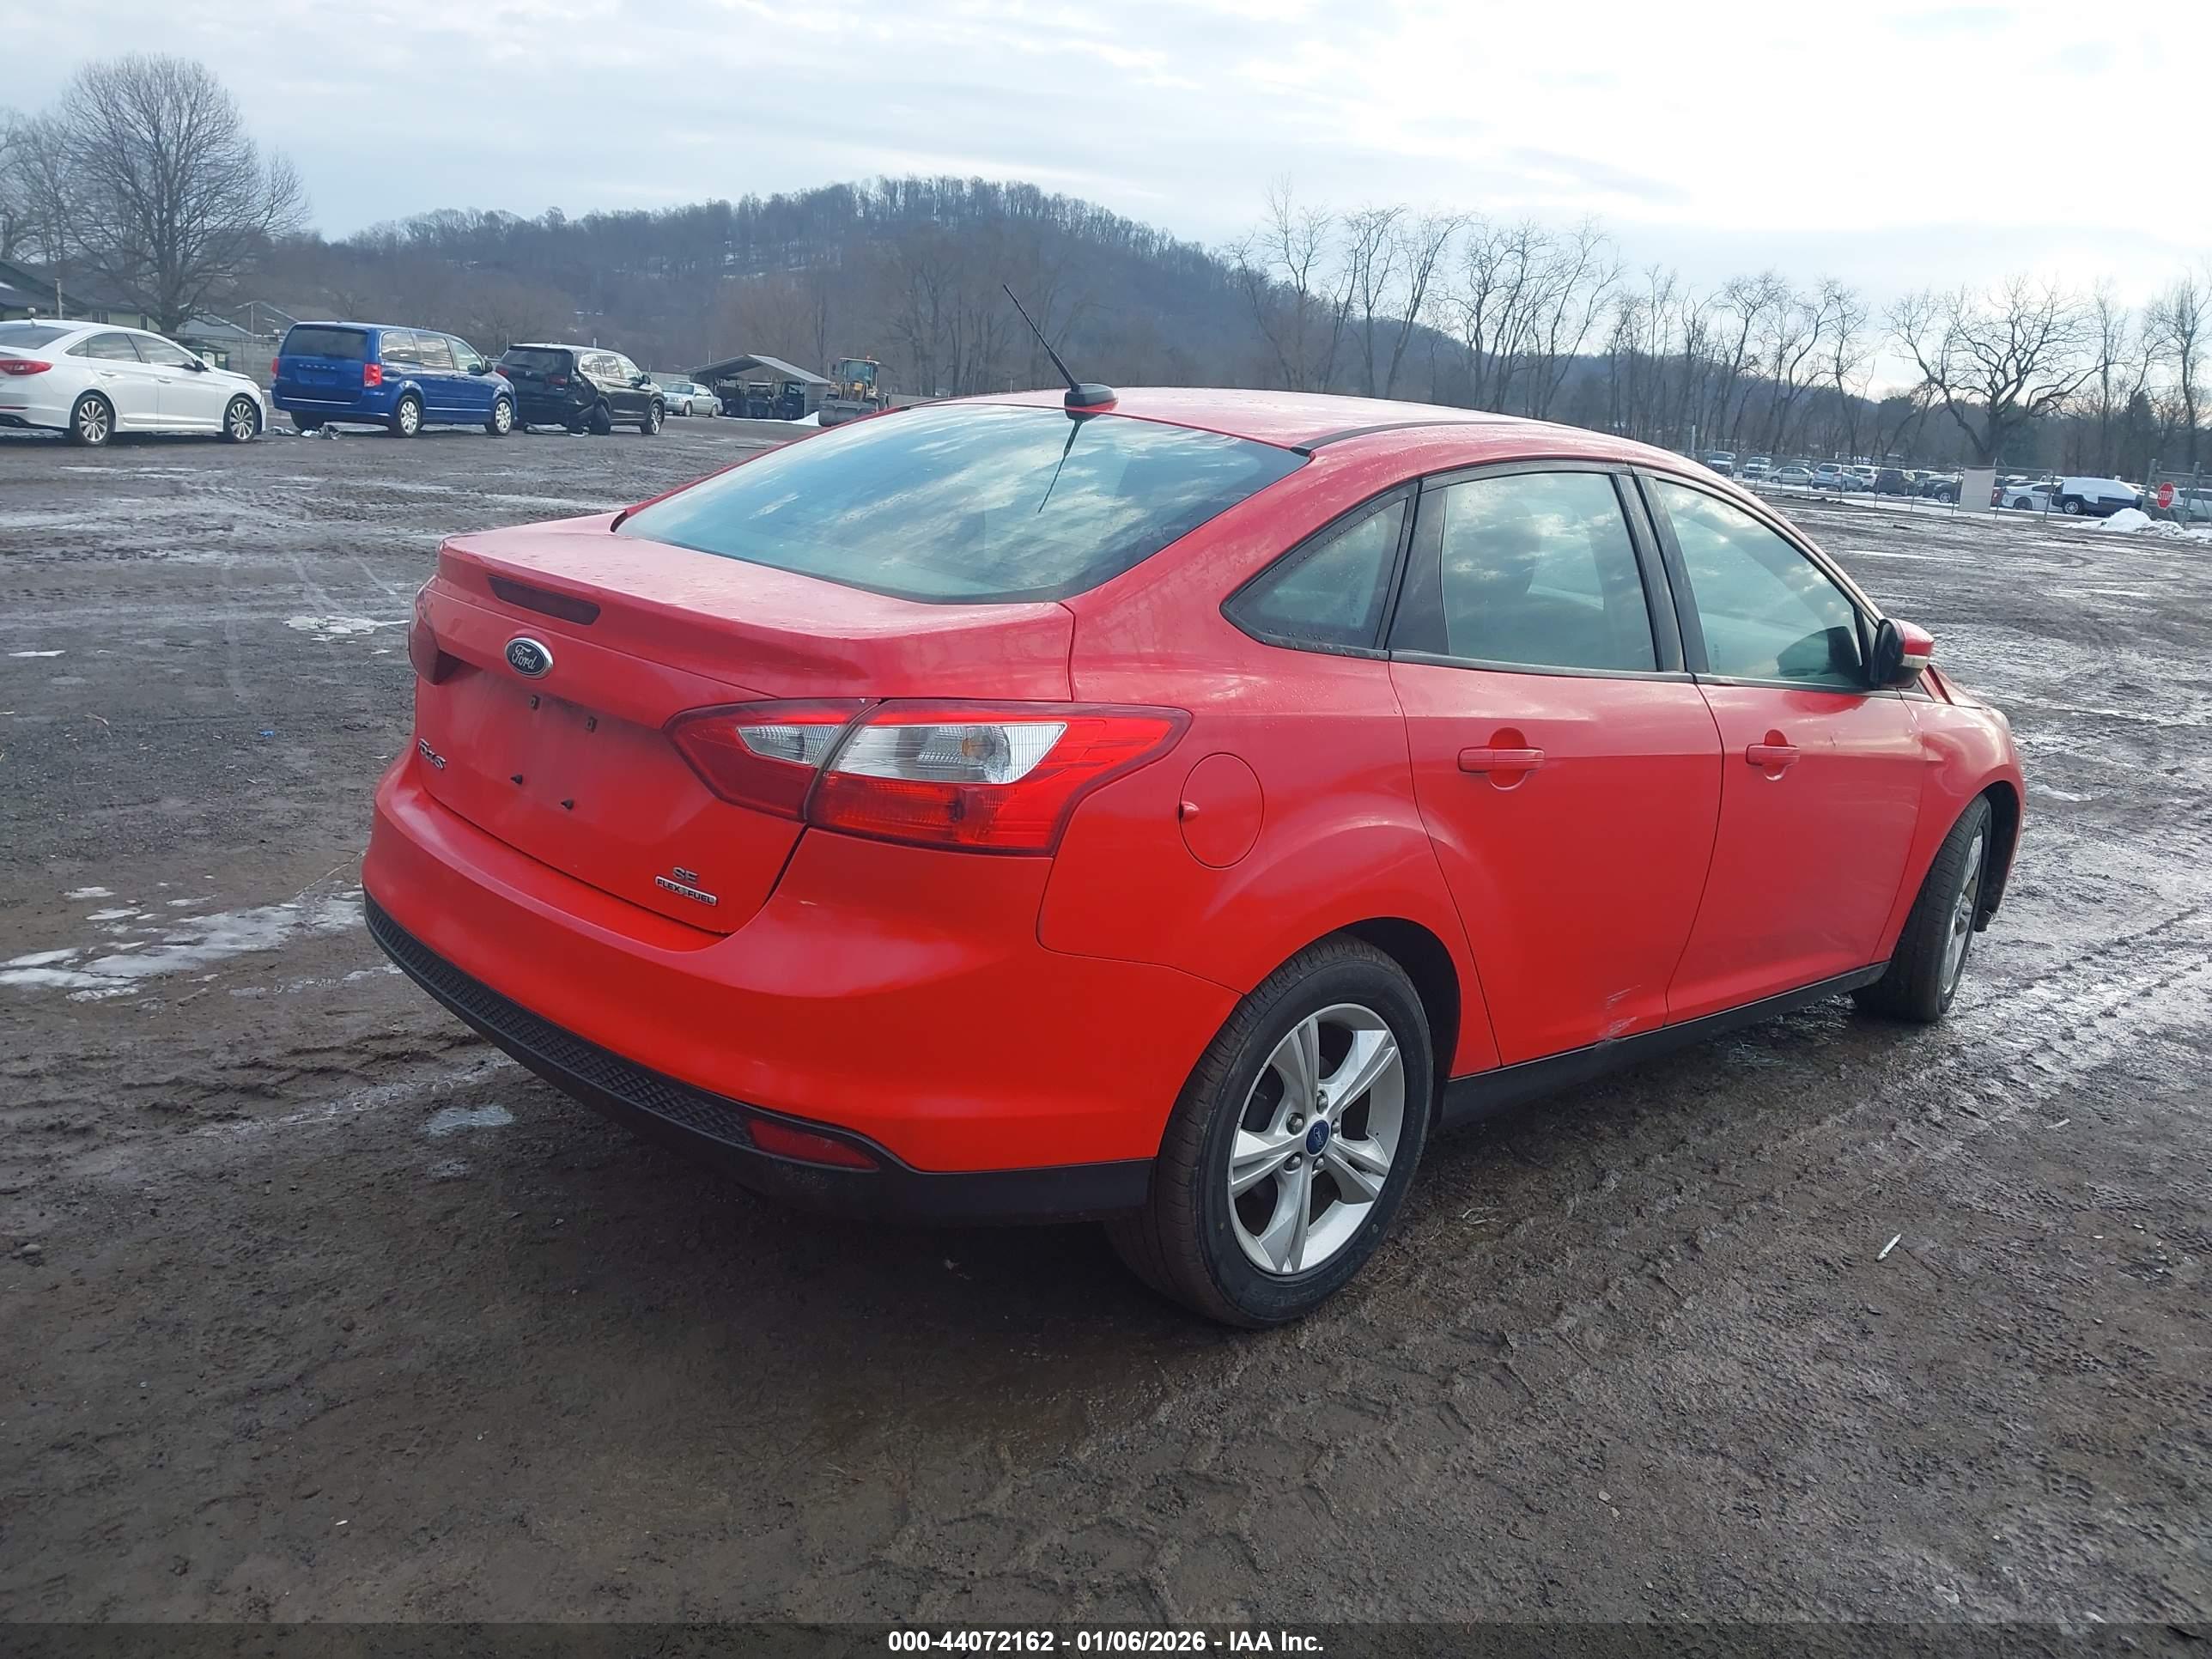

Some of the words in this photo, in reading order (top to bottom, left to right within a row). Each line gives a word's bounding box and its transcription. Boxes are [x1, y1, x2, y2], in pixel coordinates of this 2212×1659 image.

[2159, 490, 2173, 501] STOP
[511, 644, 538, 670] Ford
[672, 866, 699, 885] SE
[657, 878, 680, 893] FLEX
[687, 890, 716, 905] FUEL
